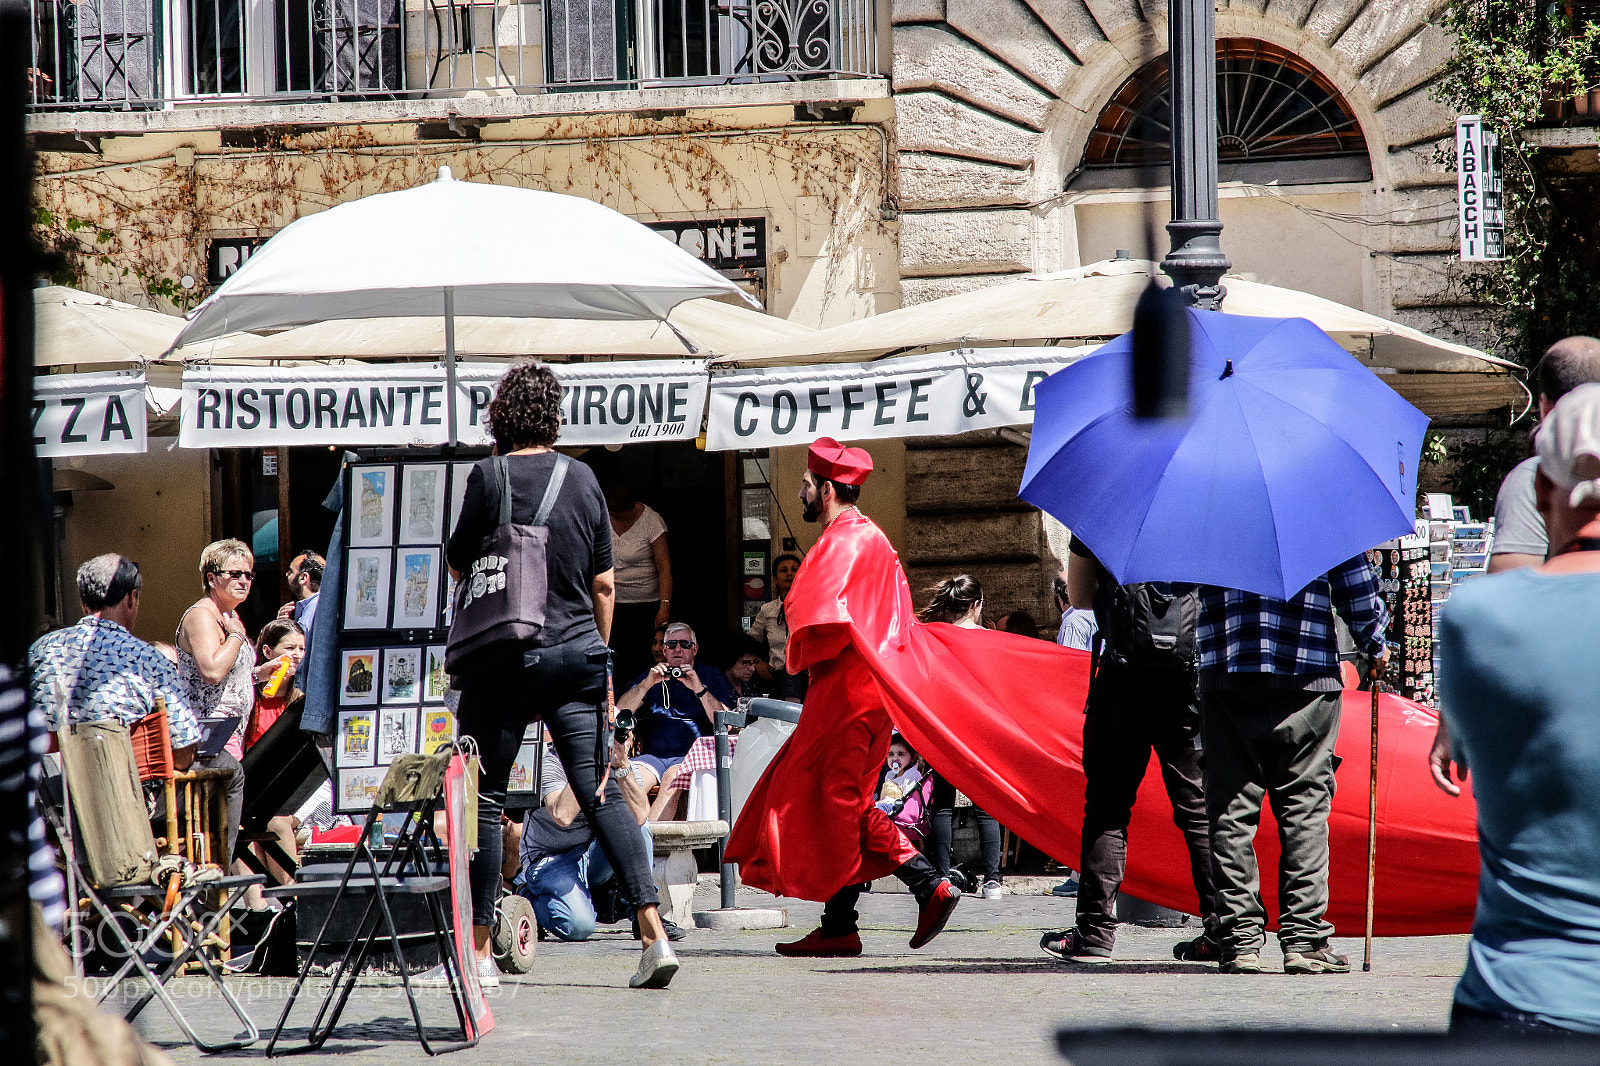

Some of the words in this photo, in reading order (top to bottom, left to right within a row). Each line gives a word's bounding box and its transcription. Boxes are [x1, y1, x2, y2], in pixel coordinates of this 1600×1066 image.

[1461, 123, 1479, 256] TABACCHI
[218, 245, 263, 277] RI
[196, 385, 443, 430] RISTORANTE
[733, 376, 933, 437] COFFEE
[962, 372, 989, 418] &
[630, 424, 650, 438] dal
[654, 422, 685, 437] 1900
